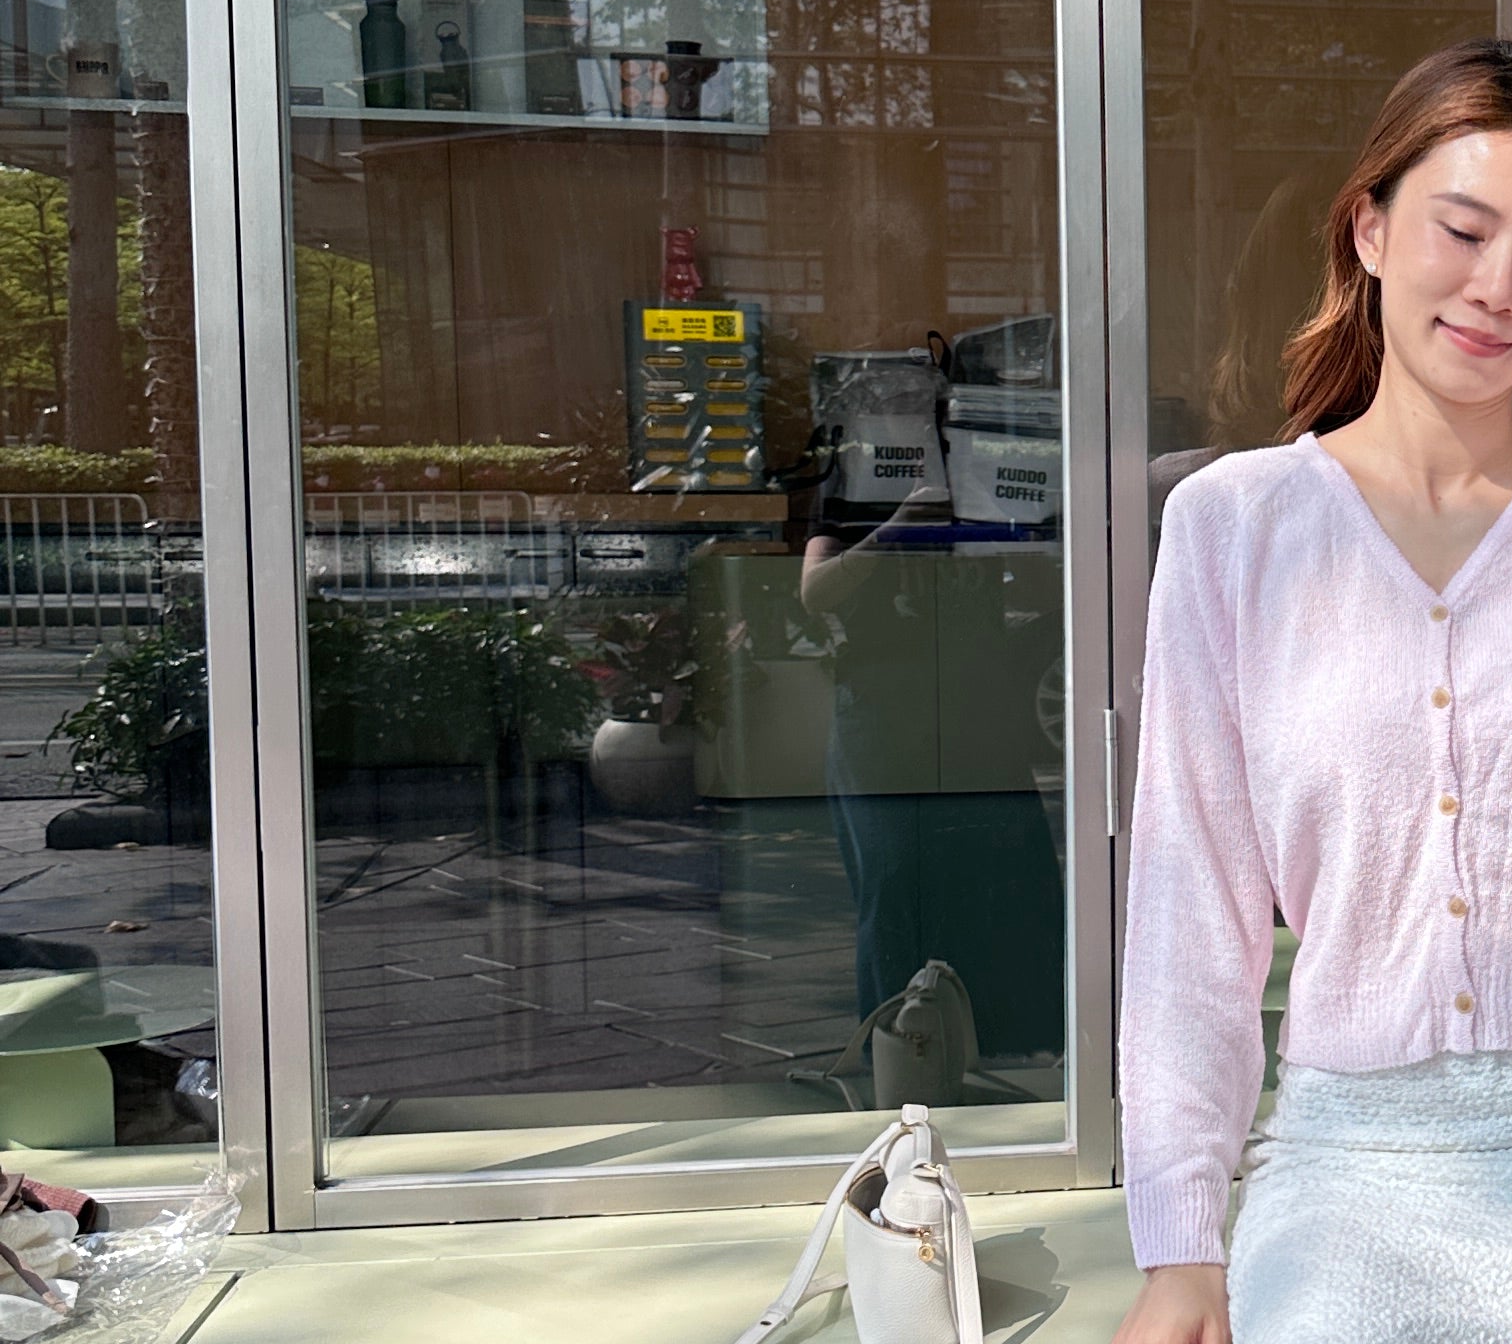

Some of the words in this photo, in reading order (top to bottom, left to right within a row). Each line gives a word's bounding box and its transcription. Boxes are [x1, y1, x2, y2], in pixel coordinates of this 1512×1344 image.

[874, 445, 925, 460] KUDDO
[874, 464, 925, 478] COFFEE
[996, 466, 1048, 486] KUDDO
[995, 484, 1046, 503] COFFEE
